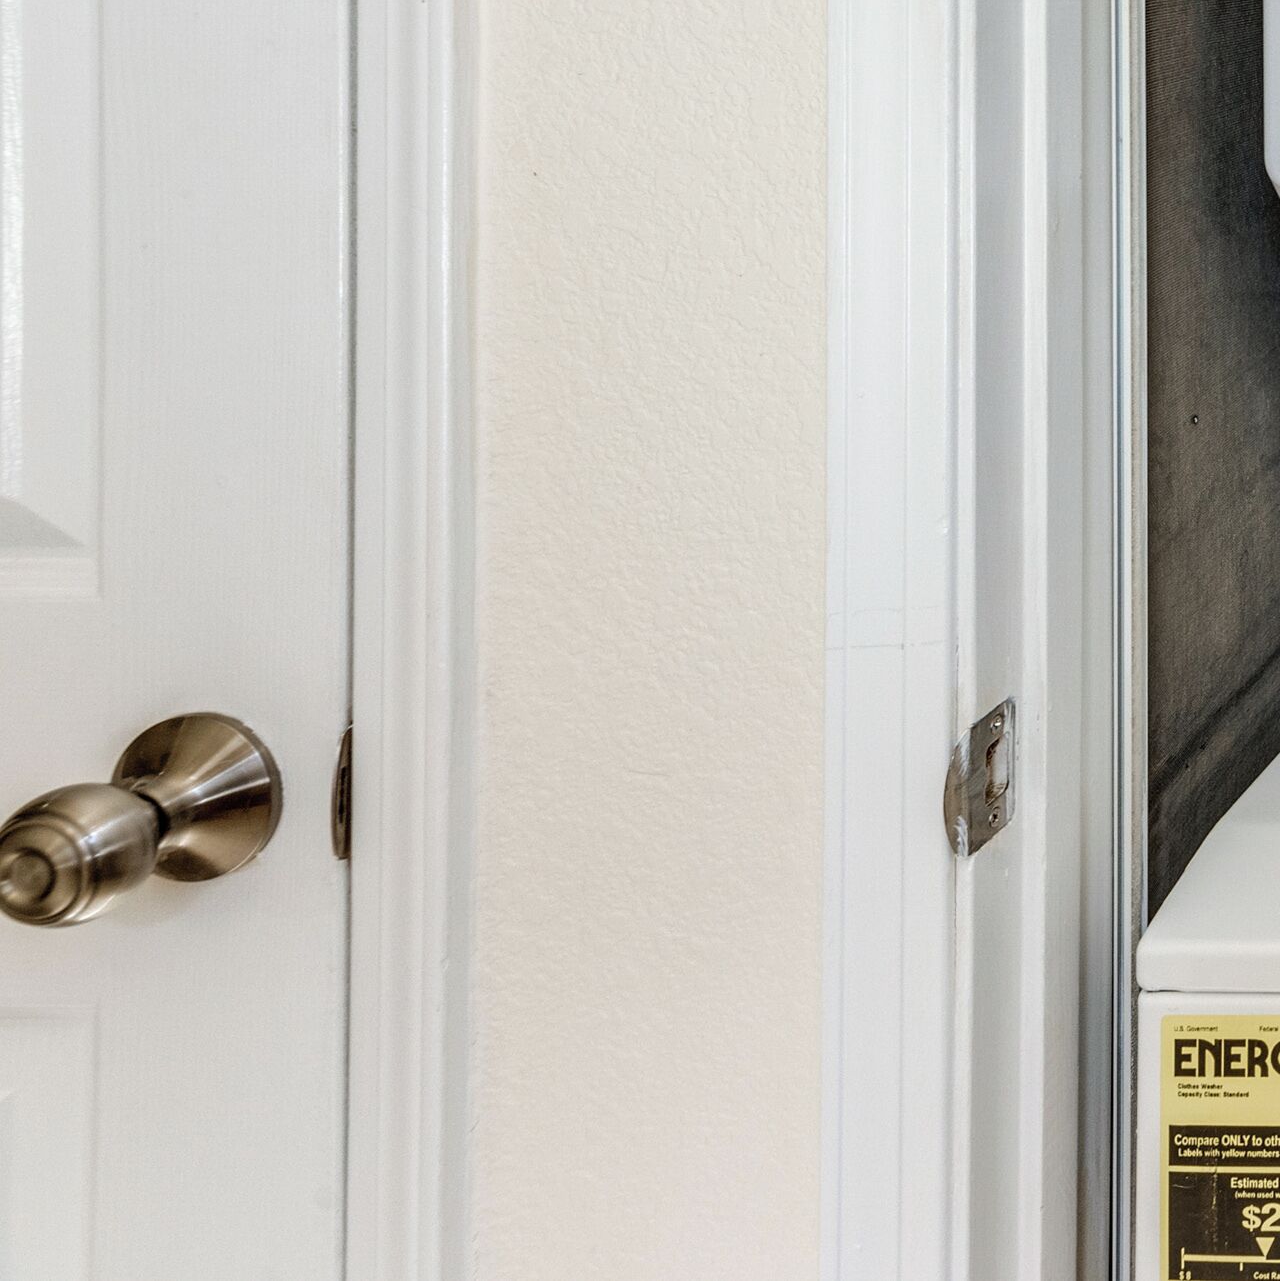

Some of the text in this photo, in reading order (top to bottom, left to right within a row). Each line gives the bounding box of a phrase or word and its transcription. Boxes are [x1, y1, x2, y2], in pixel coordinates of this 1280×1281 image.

[1174, 1134, 1219, 1148] Compare
[1221, 1134, 1250, 1147] ONLY
[1252, 1135, 1262, 1147] to
[1178, 1148, 1203, 1157] Labels
[1204, 1148, 1220, 1157] with
[1221, 1148, 1246, 1159] yellow
[1247, 1149, 1280, 1158] numbers
[1230, 1177, 1279, 1189] Estimated
[1235, 1191, 1255, 1199] (when
[1257, 1191, 1274, 1199] used
[1253, 1271, 1270, 1280] Cost
